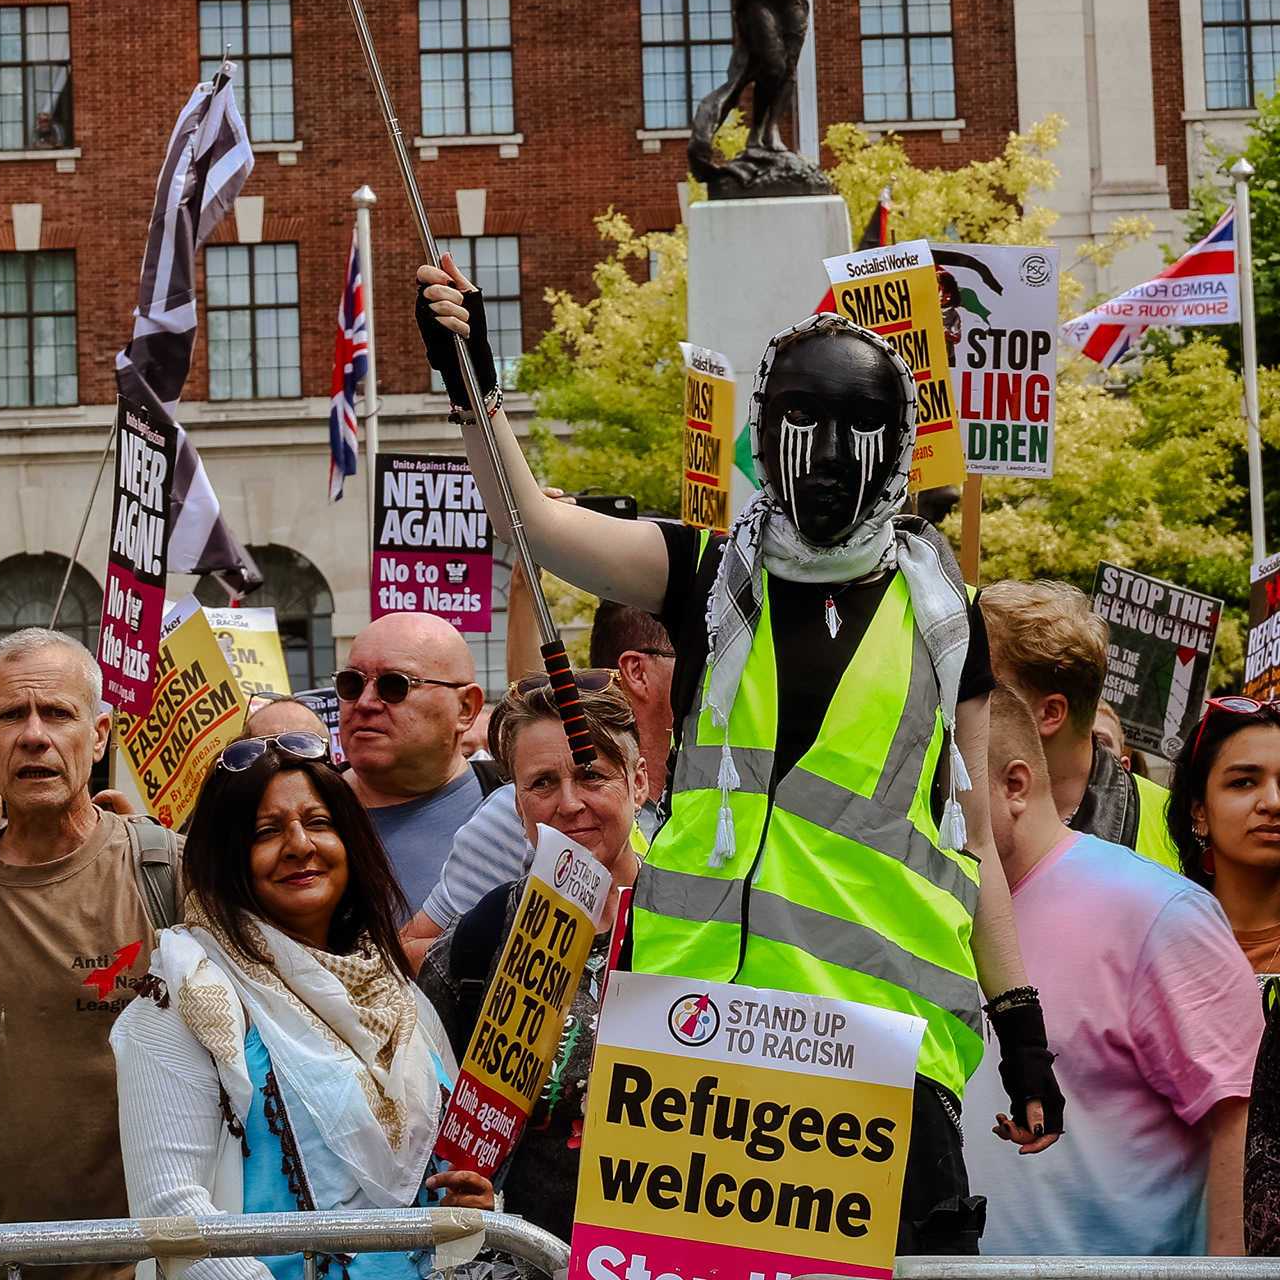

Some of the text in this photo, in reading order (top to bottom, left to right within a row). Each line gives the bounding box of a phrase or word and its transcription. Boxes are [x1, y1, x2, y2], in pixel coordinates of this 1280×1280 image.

[1027, 265, 1045, 276] PSC
[841, 278, 912, 327] SMASH
[967, 327, 1051, 371] STOP
[393, 460, 446, 472] Unite Against
[383, 471, 485, 510] NEVER
[380, 509, 487, 549] AGAIN!
[380, 558, 439, 583] No to
[107, 575, 125, 619] No
[378, 585, 482, 612] the Nazis
[1101, 566, 1214, 627] STOP THE
[102, 623, 123, 668] the
[1093, 592, 1213, 654] GENOCIDE
[1122, 647, 1141, 666] THE
[128, 659, 208, 769] FASCISM
[143, 769, 161, 800] &
[158, 680, 238, 775] RACISM
[170, 736, 222, 803] By any means
[568, 877, 580, 897] TO
[592, 874, 601, 892] UP
[519, 889, 578, 960] NO TO
[71, 954, 109, 969] Anti
[502, 932, 573, 1017] RACISM,
[486, 976, 547, 1047] NO TO
[726, 999, 847, 1039] STAND UP
[470, 1015, 545, 1102] FASCISM
[724, 1026, 856, 1069] TO RACISM
[454, 1077, 517, 1140] Unite against
[606, 1062, 898, 1163] Refugees
[443, 1111, 502, 1171] the far right
[599, 1152, 873, 1238] welcome
